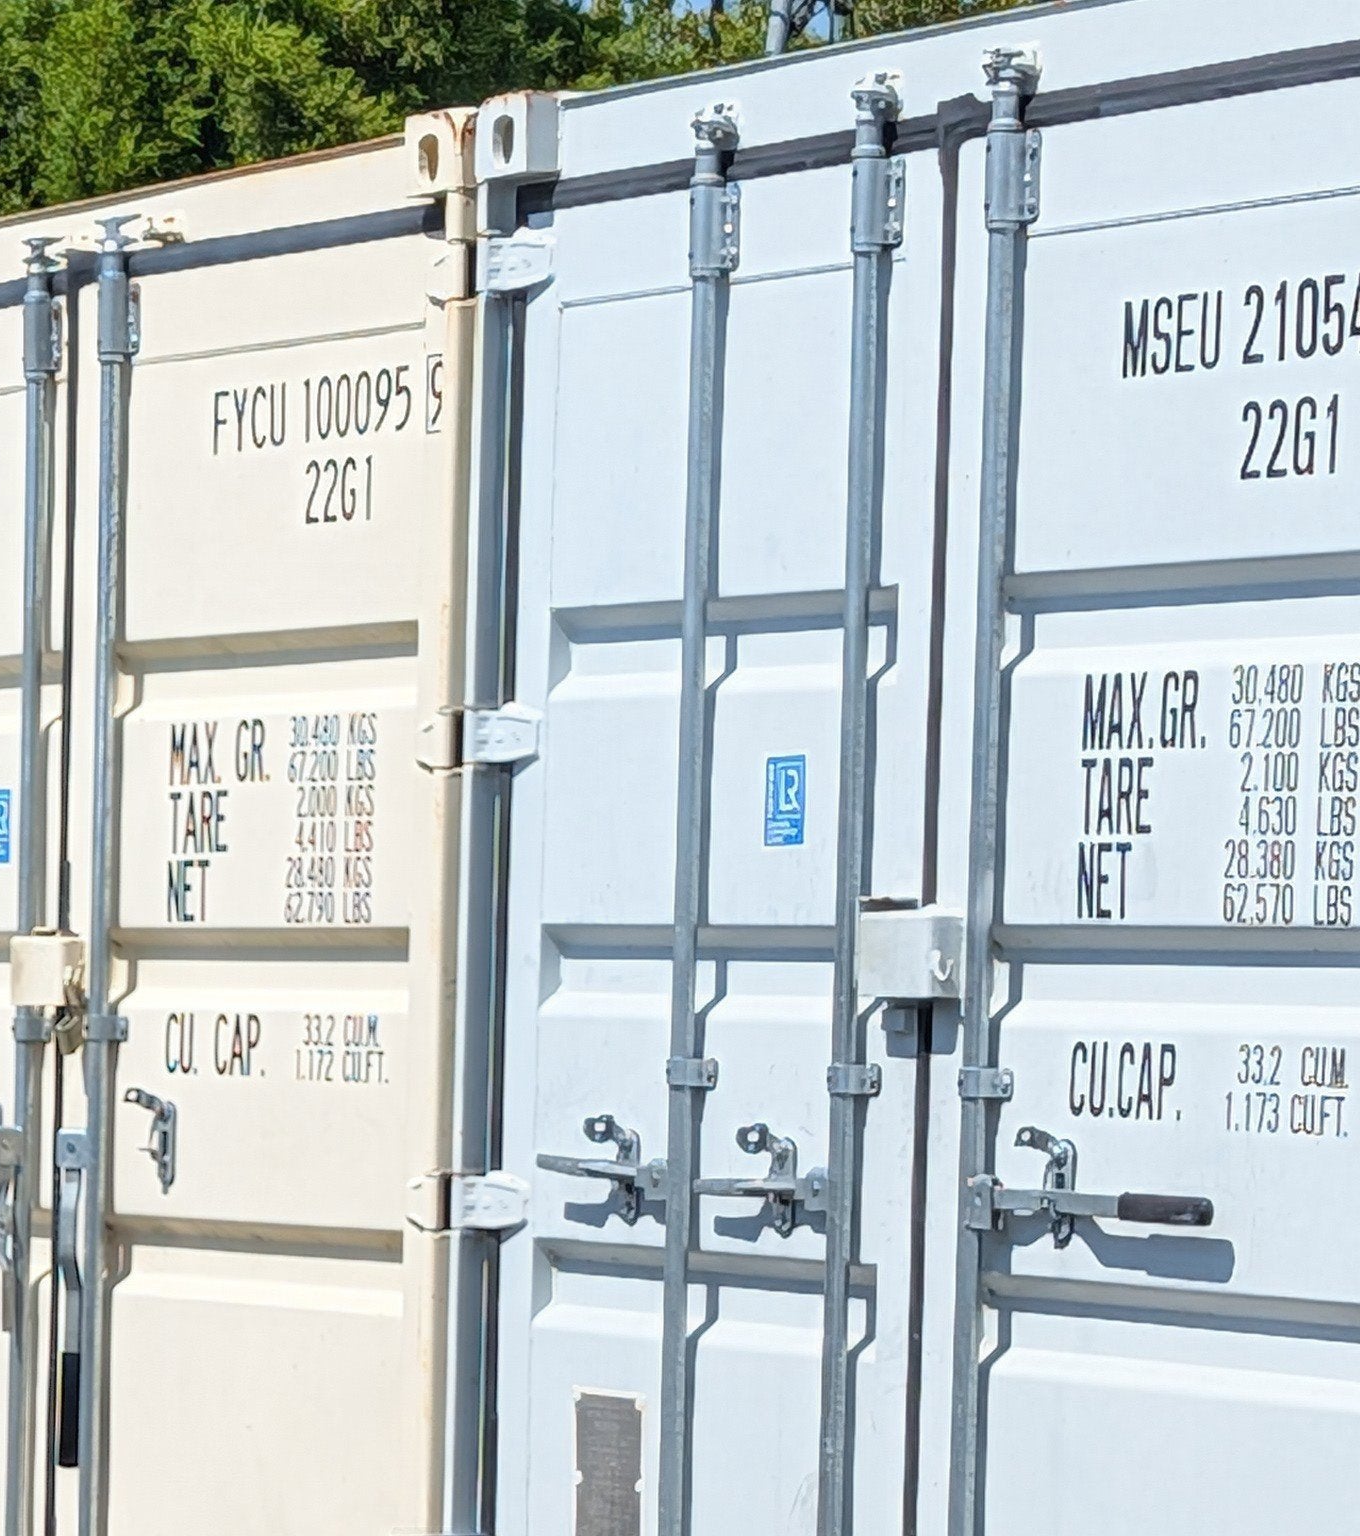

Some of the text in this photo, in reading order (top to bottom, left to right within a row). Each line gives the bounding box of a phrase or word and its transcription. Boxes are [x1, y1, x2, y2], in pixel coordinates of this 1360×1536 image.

[1122, 289, 1223, 379] MSEU
[213, 381, 286, 456] FYCU
[303, 364, 412, 444] 100095
[1240, 393, 1339, 480] 22G1
[305, 454, 373, 525] 22G1
[1321, 661, 1360, 704] KGS
[346, 712, 377, 746] KGS
[1320, 706, 1360, 749] LBS
[168, 718, 272, 786] MAX. GR.
[346, 748, 377, 782] LBS
[1317, 751, 1359, 794] KGS
[344, 783, 375, 818] KGS
[1081, 756, 1155, 836] TARE
[1316, 795, 1358, 837] LBS
[169, 789, 229, 854] TARE
[344, 820, 374, 853] LBS
[342, 855, 373, 889] KGS
[1077, 841, 1133, 920] NET
[1314, 839, 1355, 882] KGS
[166, 859, 211, 923] NET
[342, 891, 372, 925] LBS
[1313, 883, 1354, 926] LBS
[165, 1012, 266, 1077] CU. CAP.
[1237, 1043, 1283, 1087] 33.2
